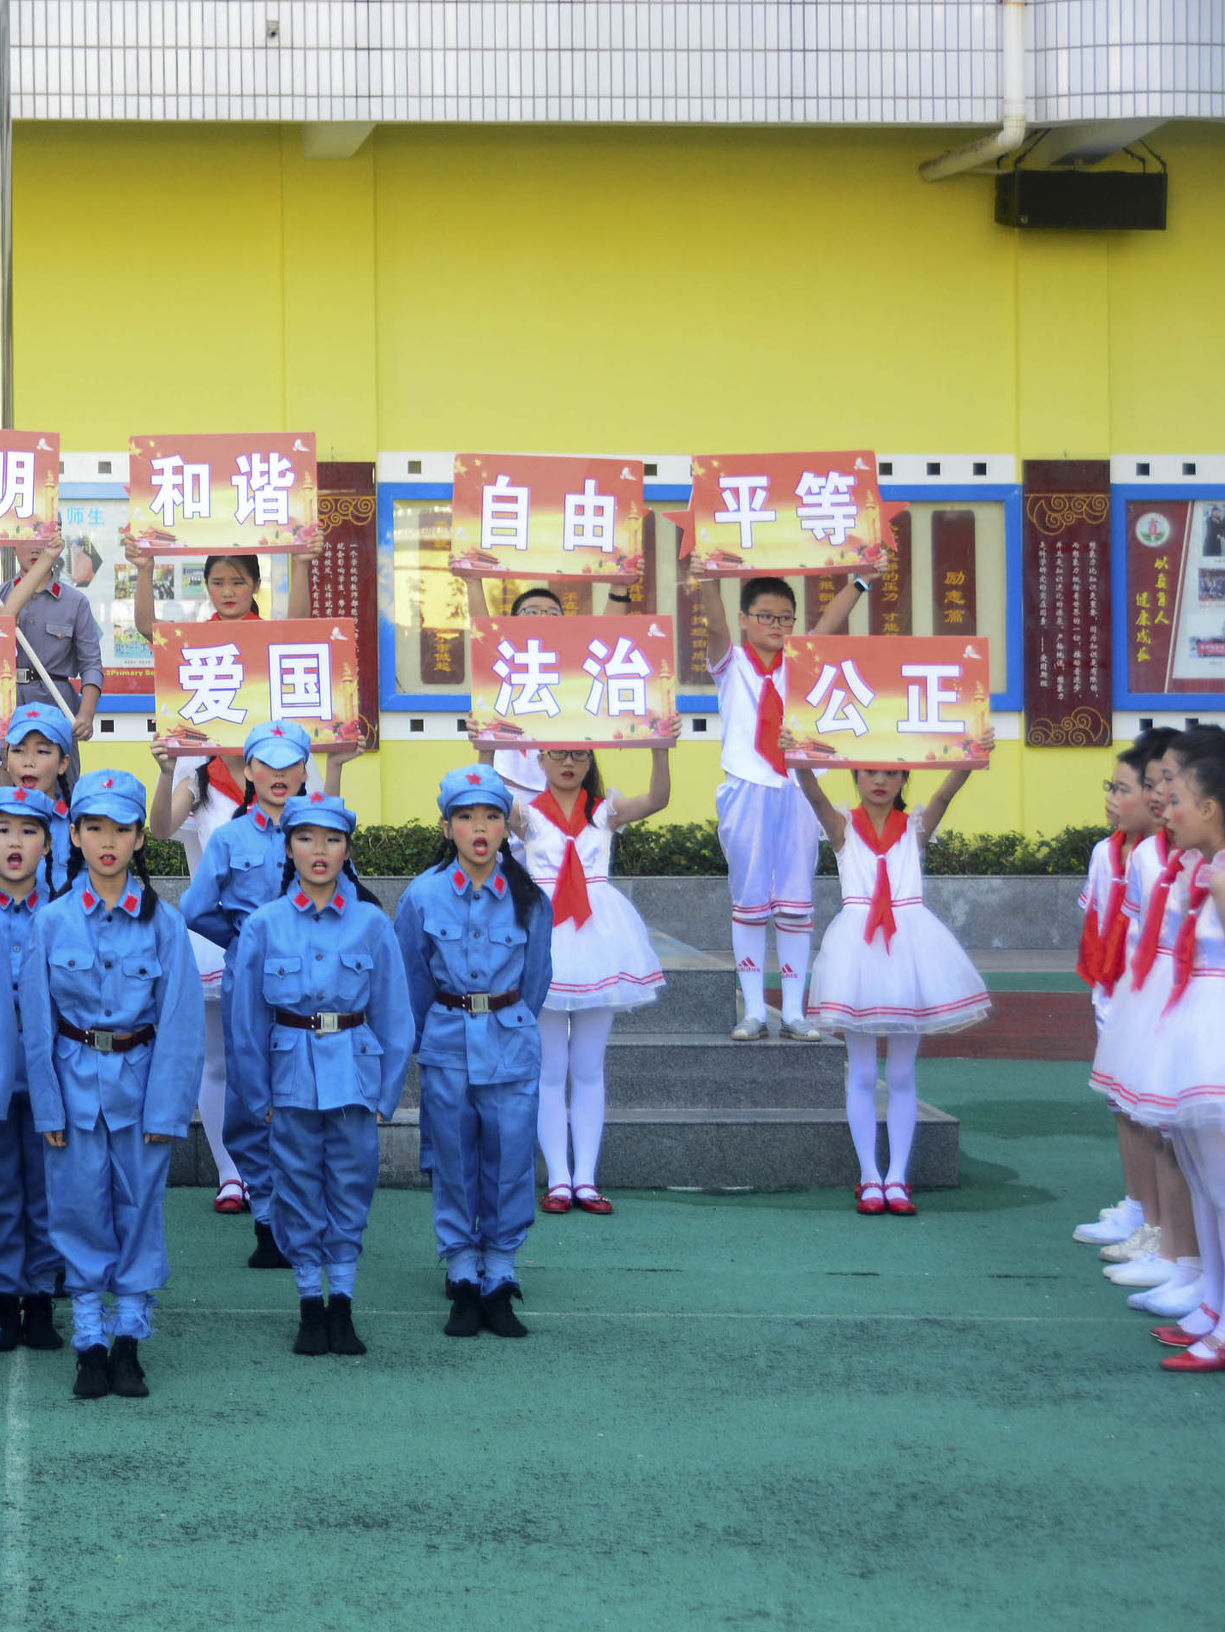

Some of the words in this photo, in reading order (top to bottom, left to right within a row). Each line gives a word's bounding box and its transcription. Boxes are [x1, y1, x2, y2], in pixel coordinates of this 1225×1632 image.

[67, 506, 104, 525] 师生
[149, 451, 298, 528] 和谐
[479, 474, 618, 553] 自由
[714, 470, 858, 549] 平等
[178, 642, 334, 726] 爱国
[492, 636, 653, 718] 法治
[806, 659, 967, 739] 公正
